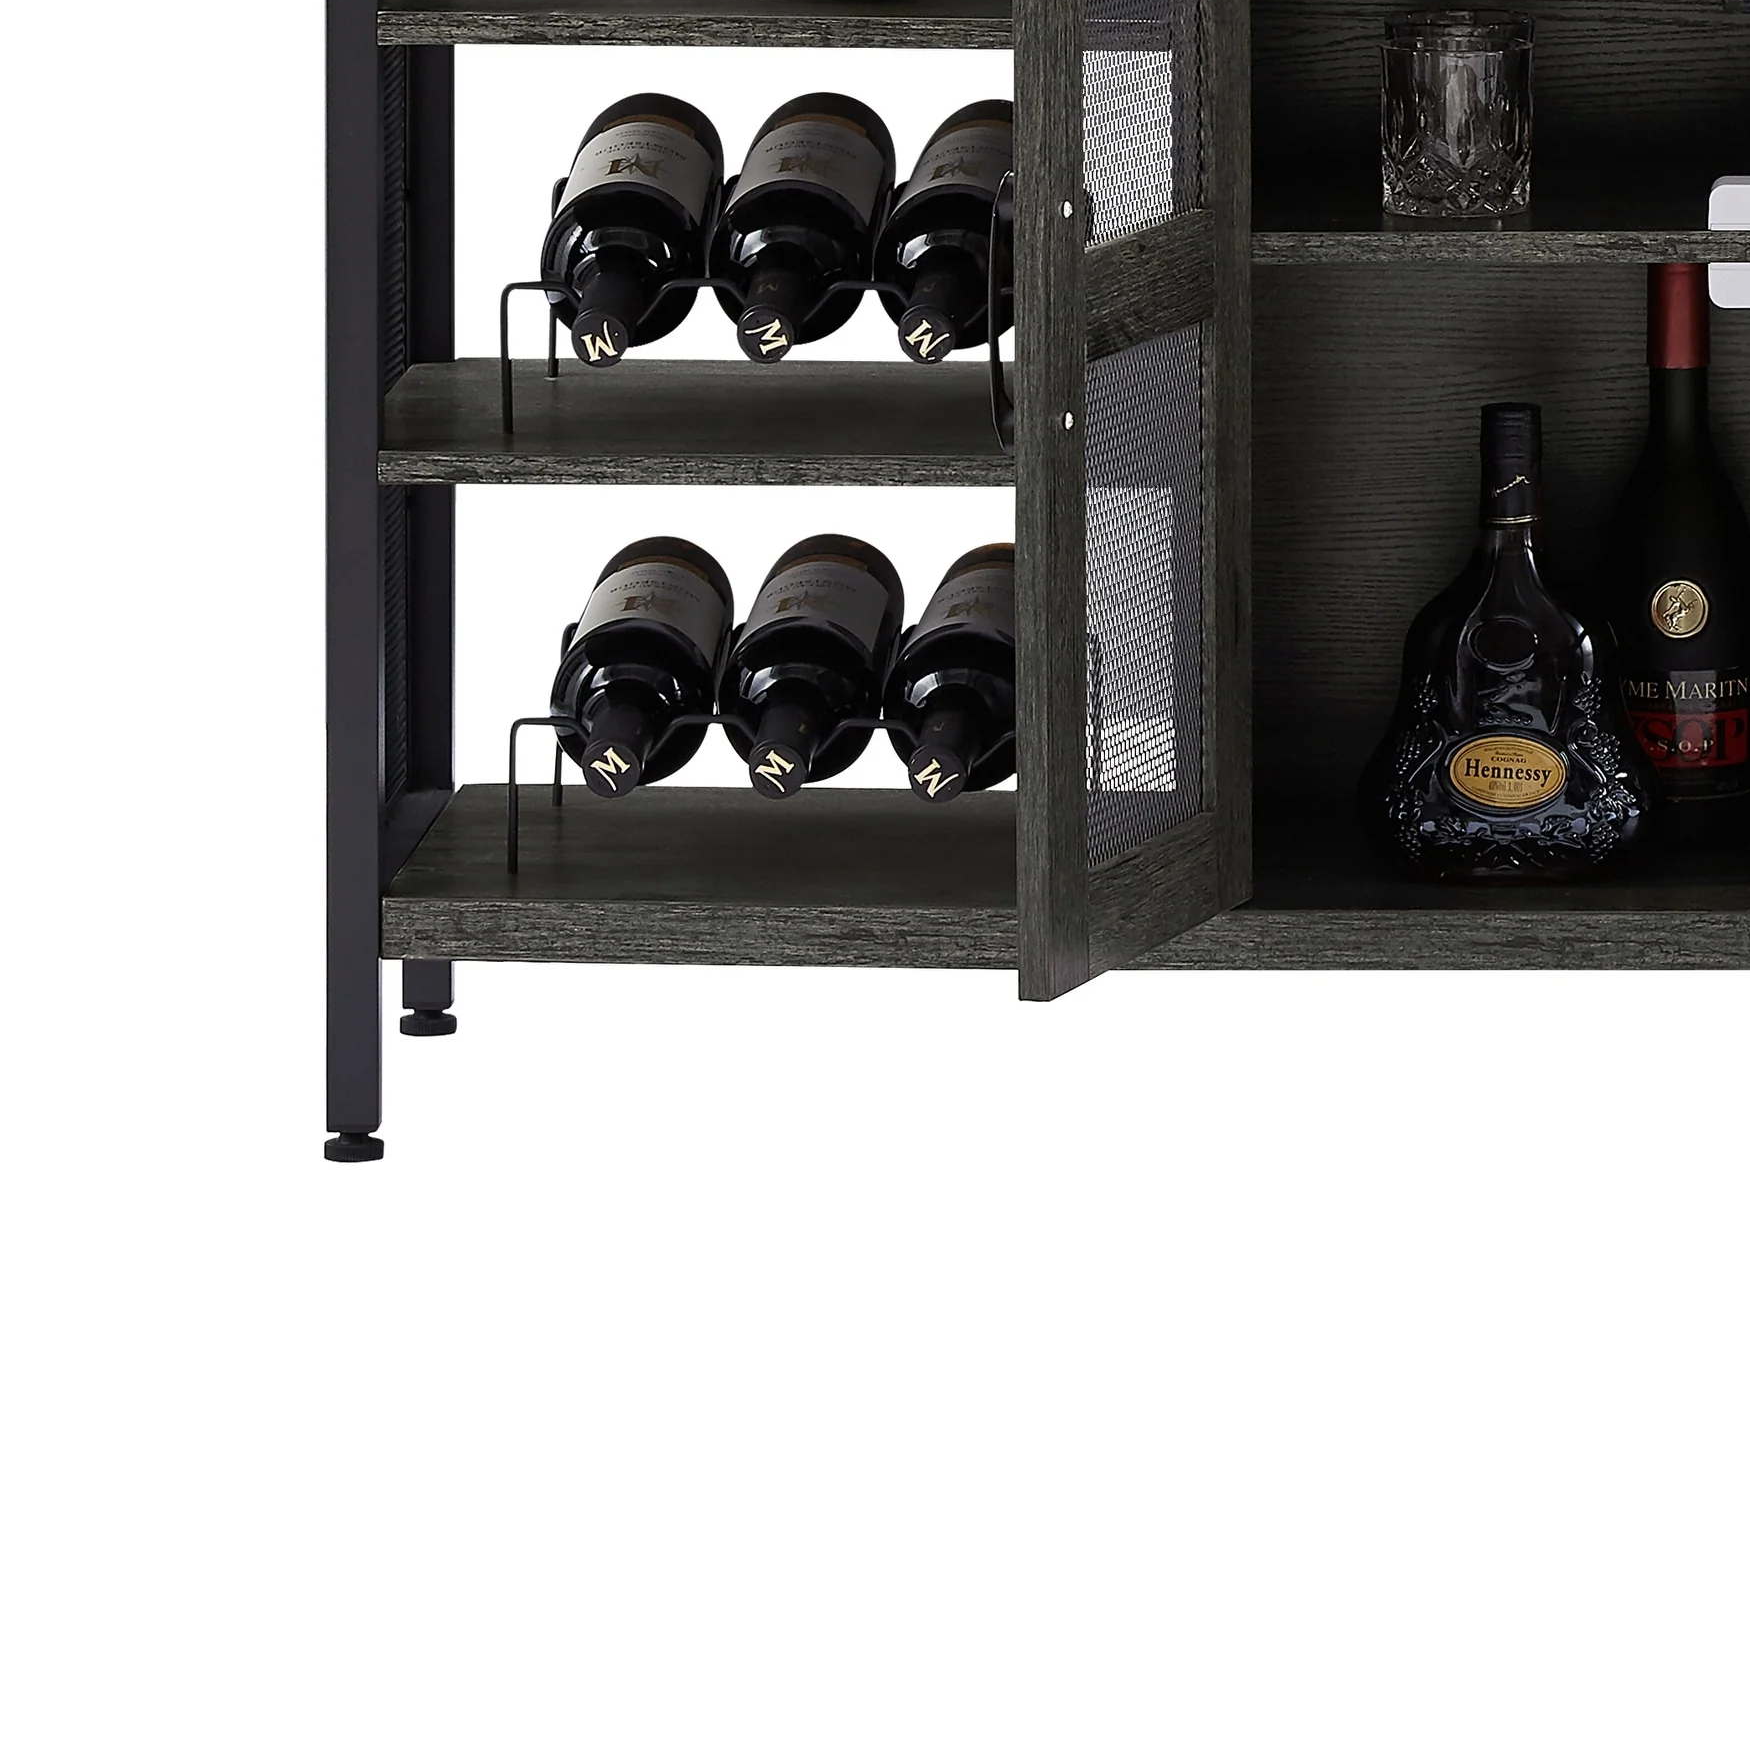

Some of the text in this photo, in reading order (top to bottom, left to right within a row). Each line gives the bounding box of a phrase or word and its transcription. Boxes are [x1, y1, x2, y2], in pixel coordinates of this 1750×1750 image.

[580, 319, 619, 363] M
[743, 317, 789, 356] M
[904, 318, 951, 359] M
[1664, 677, 1749, 700] MARITN
[589, 746, 631, 792] M
[754, 749, 796, 793] M
[913, 757, 960, 799] M
[1464, 758, 1552, 788] Hennessy
